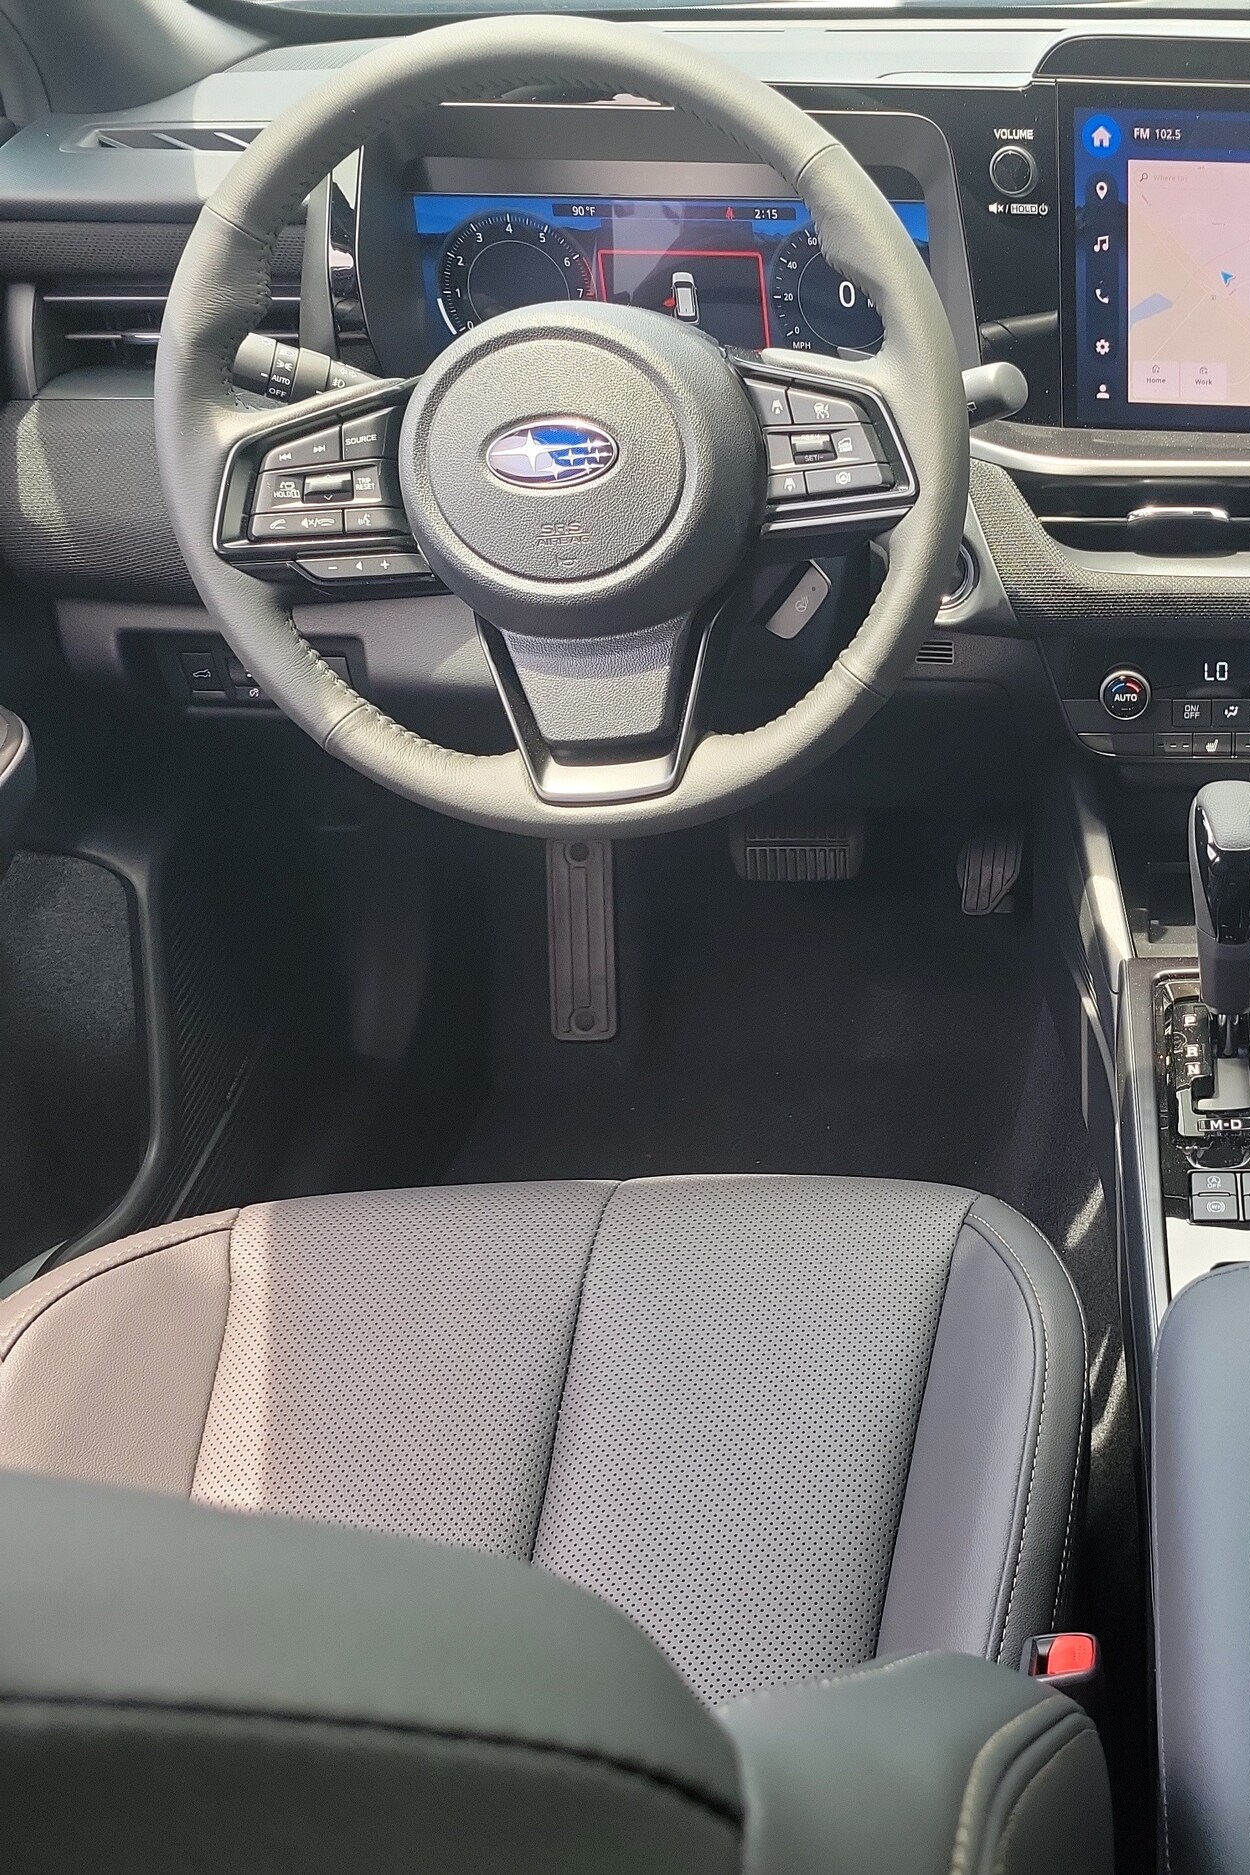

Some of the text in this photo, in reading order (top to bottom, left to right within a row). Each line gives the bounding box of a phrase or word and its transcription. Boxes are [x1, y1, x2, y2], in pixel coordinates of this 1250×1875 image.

[993, 128, 1034, 139] VOLUME
[1133, 127, 1181, 140] FM 102.5
[754, 209, 778, 219] 2:15
[1011, 204, 1038, 214] HOLD
[505, 223, 513, 234] 4
[475, 233, 483, 243] 3
[539, 233, 546, 243] 5
[807, 237, 818, 246] 60
[457, 256, 464, 266] 2
[564, 258, 571, 267] 6
[787, 261, 797, 269] 40
[455, 288, 461, 298] 1
[576, 289, 583, 298] 7
[784, 293, 793, 301] 20
[838, 281, 856, 308] 0
[467, 321, 474, 329] 0
[794, 326, 800, 334] 0
[271, 374, 291, 385] AUTO
[1195, 378, 1212, 386] Work
[268, 387, 287, 397] OFF
[345, 434, 377, 446] SOURCE
[540, 521, 582, 535] SRS
[1204, 661, 1228, 681] LO
[1114, 693, 1138, 702] AUTO
[1184, 1015, 1197, 1026] P
[1187, 1064, 1200, 1075] N
